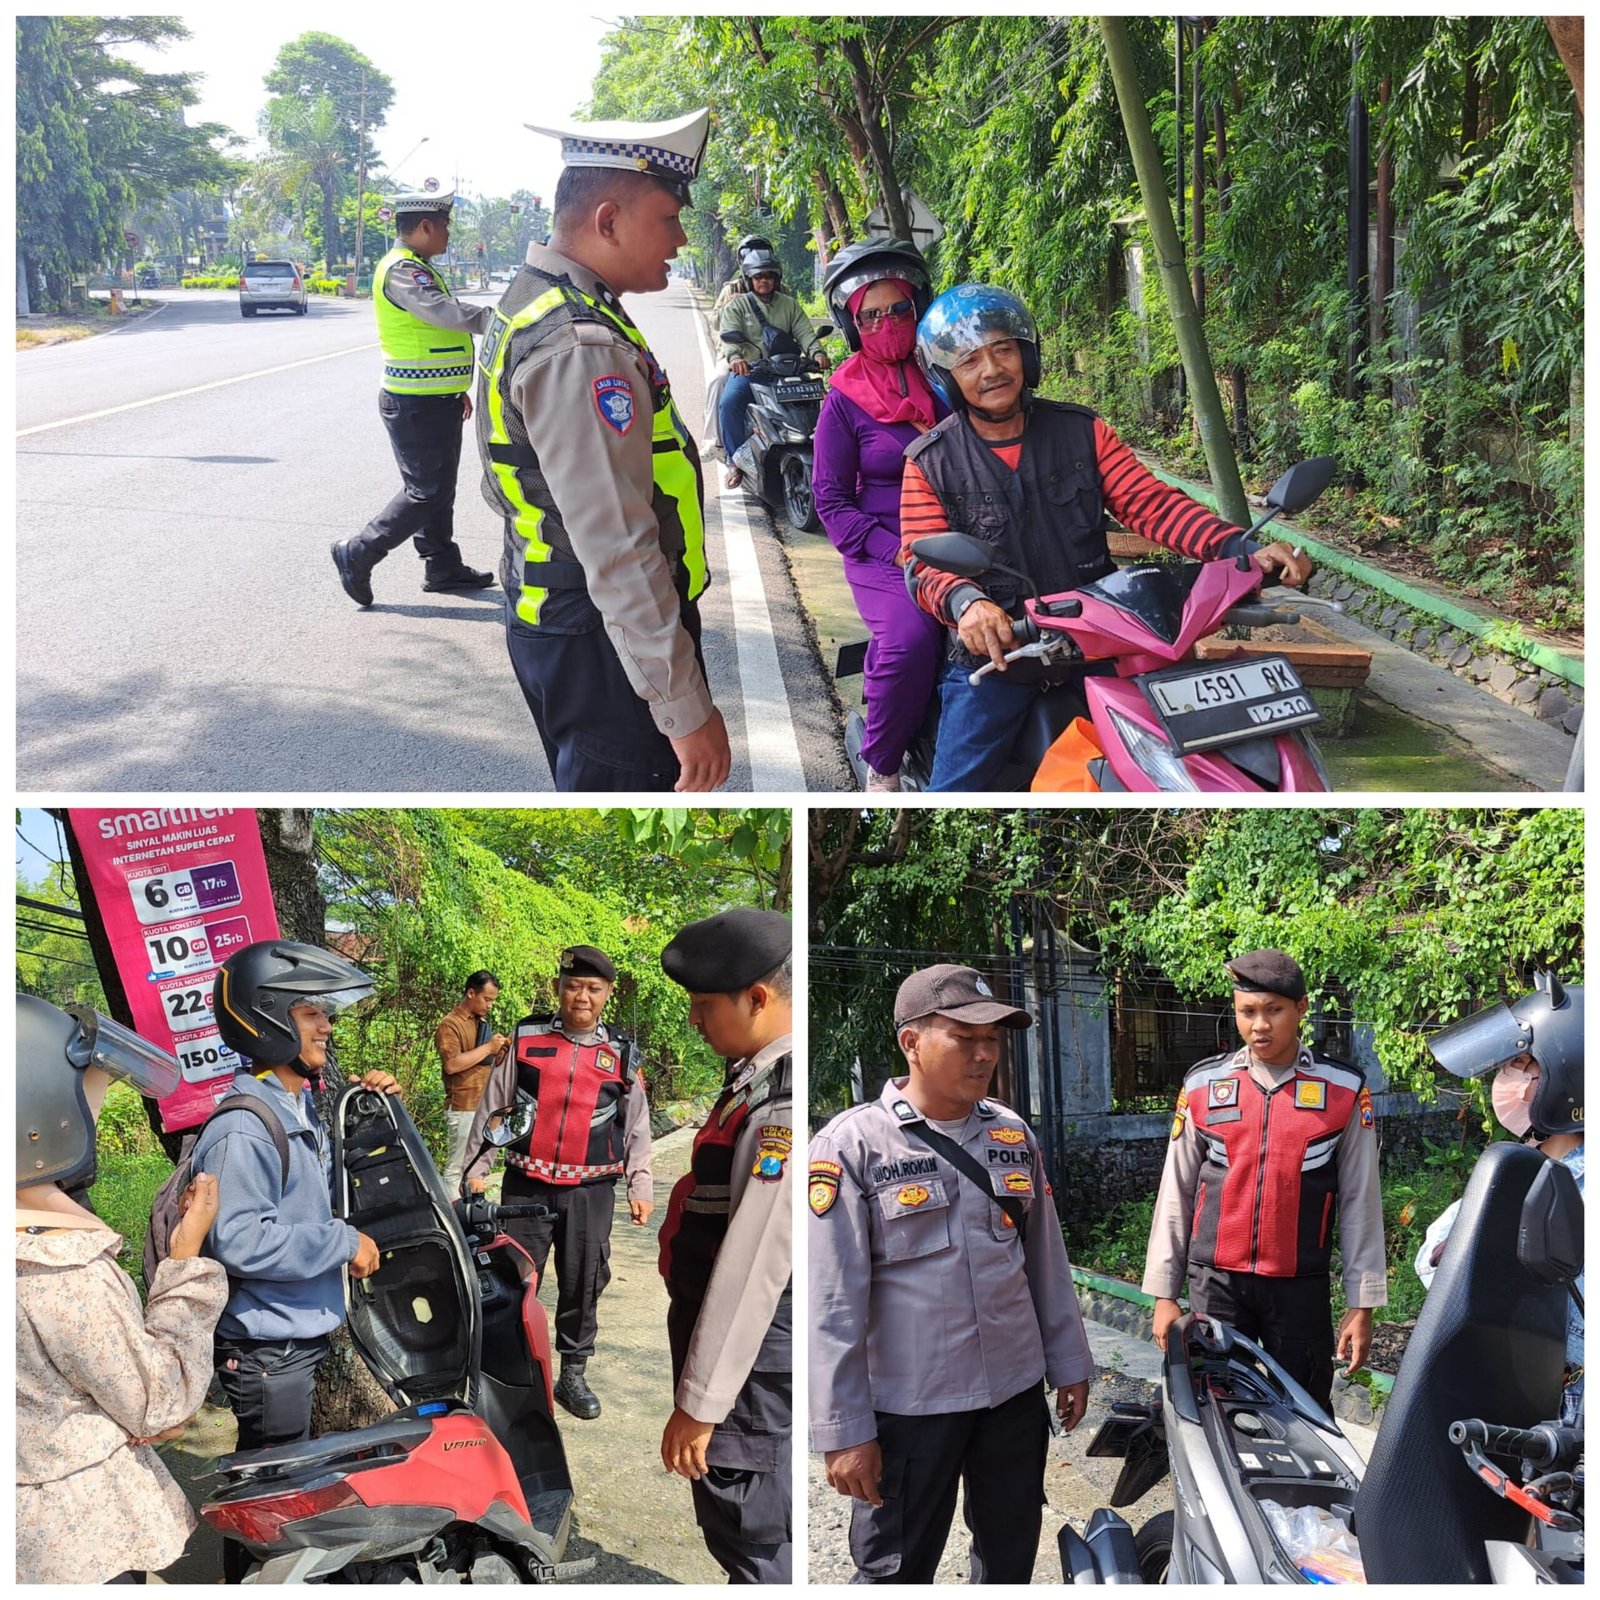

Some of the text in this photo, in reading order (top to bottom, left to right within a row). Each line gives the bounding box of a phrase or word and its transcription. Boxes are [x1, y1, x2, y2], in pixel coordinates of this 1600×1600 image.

[1158, 687, 1179, 712] L
[1194, 673, 1247, 705] 4591
[112, 833, 236, 866] INTERNETAN SUPER CEPAT
[126, 825, 218, 851] SINYAL MAKIN LUAS
[126, 865, 168, 880] KUOTA IRIT
[144, 877, 227, 909] 6 GB 17rb
[143, 918, 203, 937] KUOTA NONSTOP
[148, 933, 244, 965] 10 GB 25rb
[159, 981, 184, 992] KUOTA
[166, 989, 206, 1018] 22
[174, 1033, 198, 1043] KUOTA
[180, 1047, 219, 1070] 150
[443, 1438, 487, 1452] VARIO
